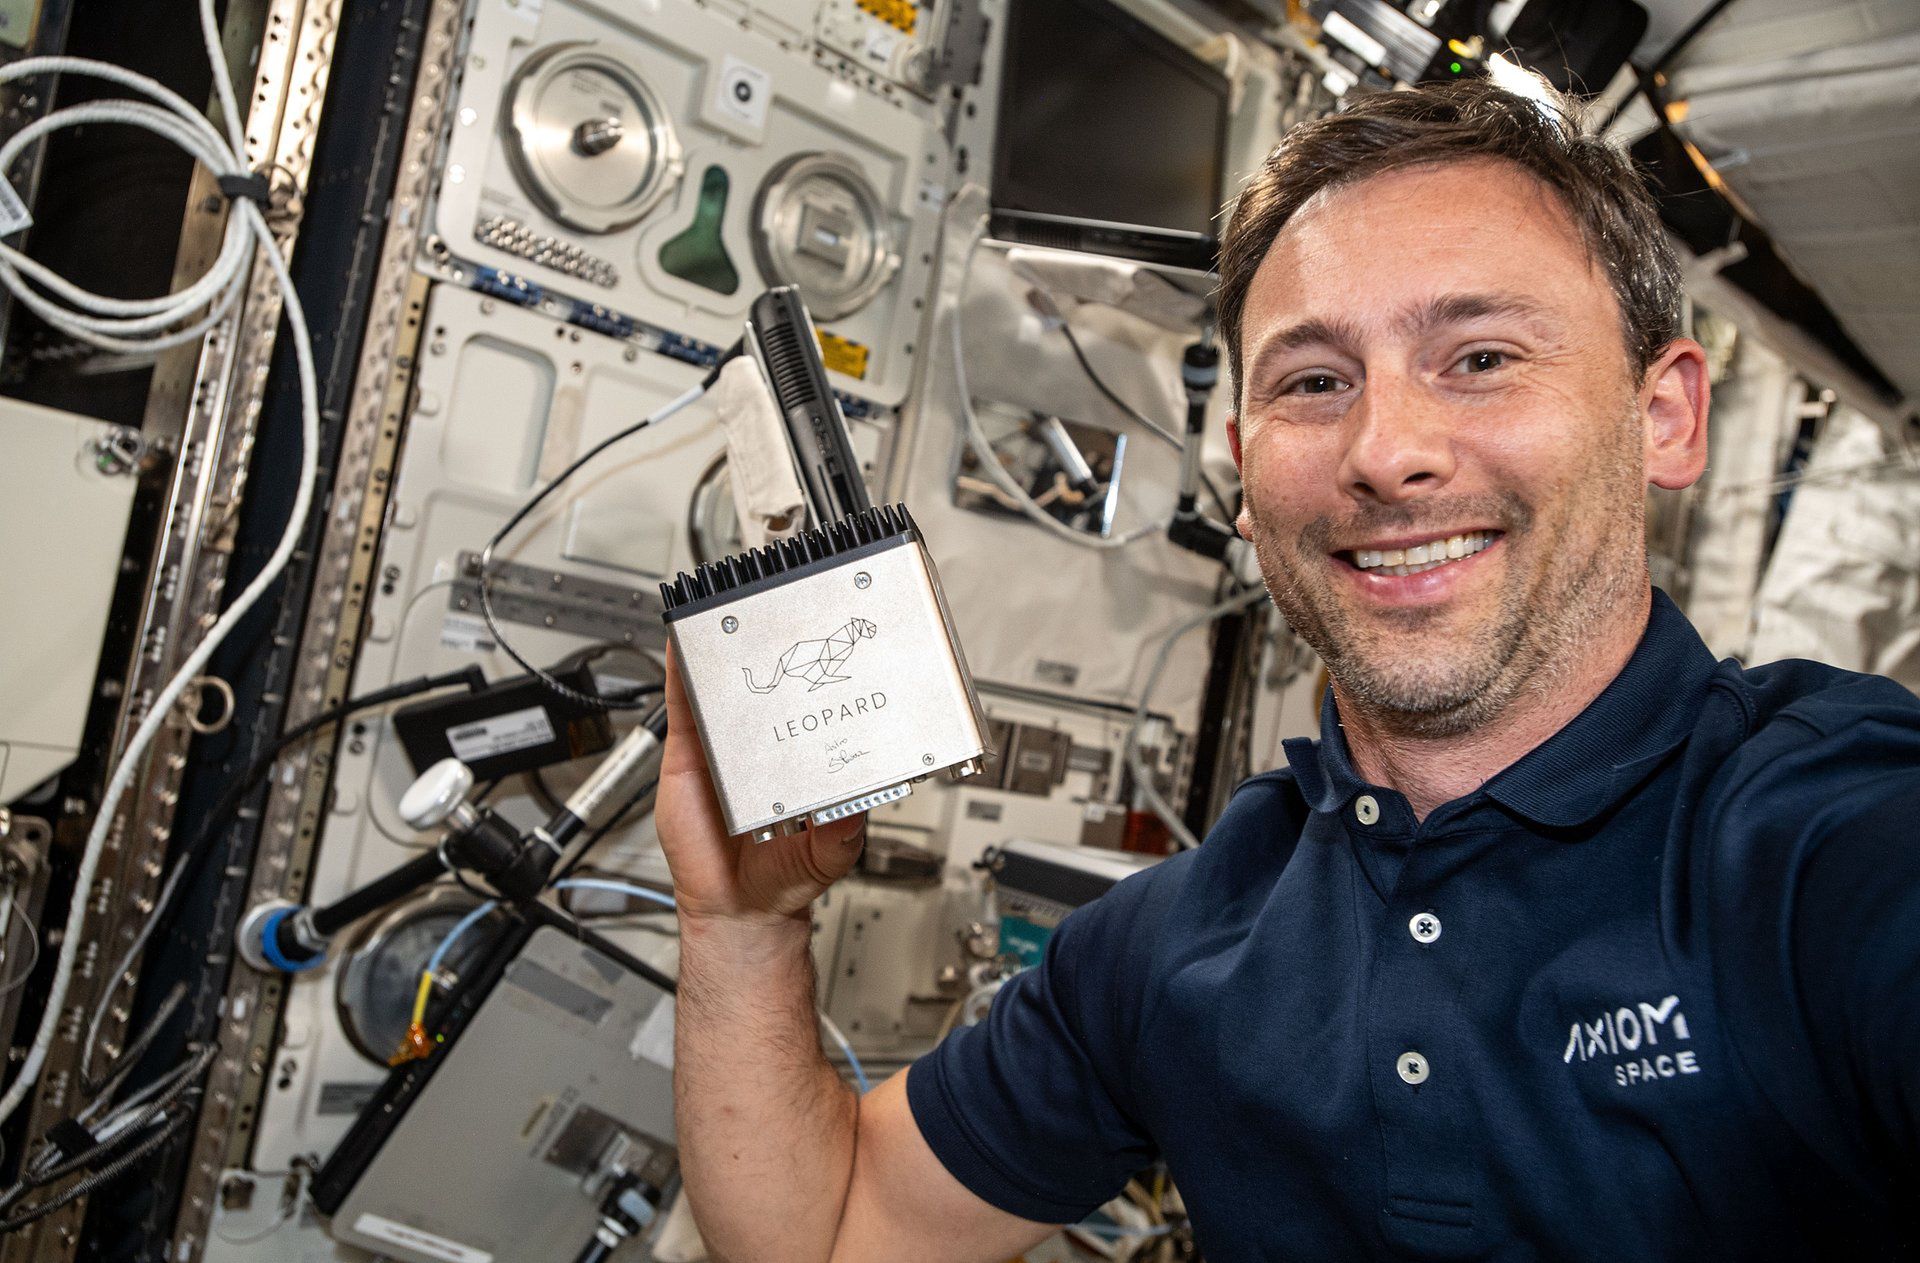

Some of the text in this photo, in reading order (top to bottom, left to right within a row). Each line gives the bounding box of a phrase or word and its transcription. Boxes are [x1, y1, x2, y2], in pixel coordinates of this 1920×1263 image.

[773, 691, 887, 742] LEOPARD
[1563, 994, 1691, 1064] AXIOM
[1614, 1050, 1701, 1087] SPACE
